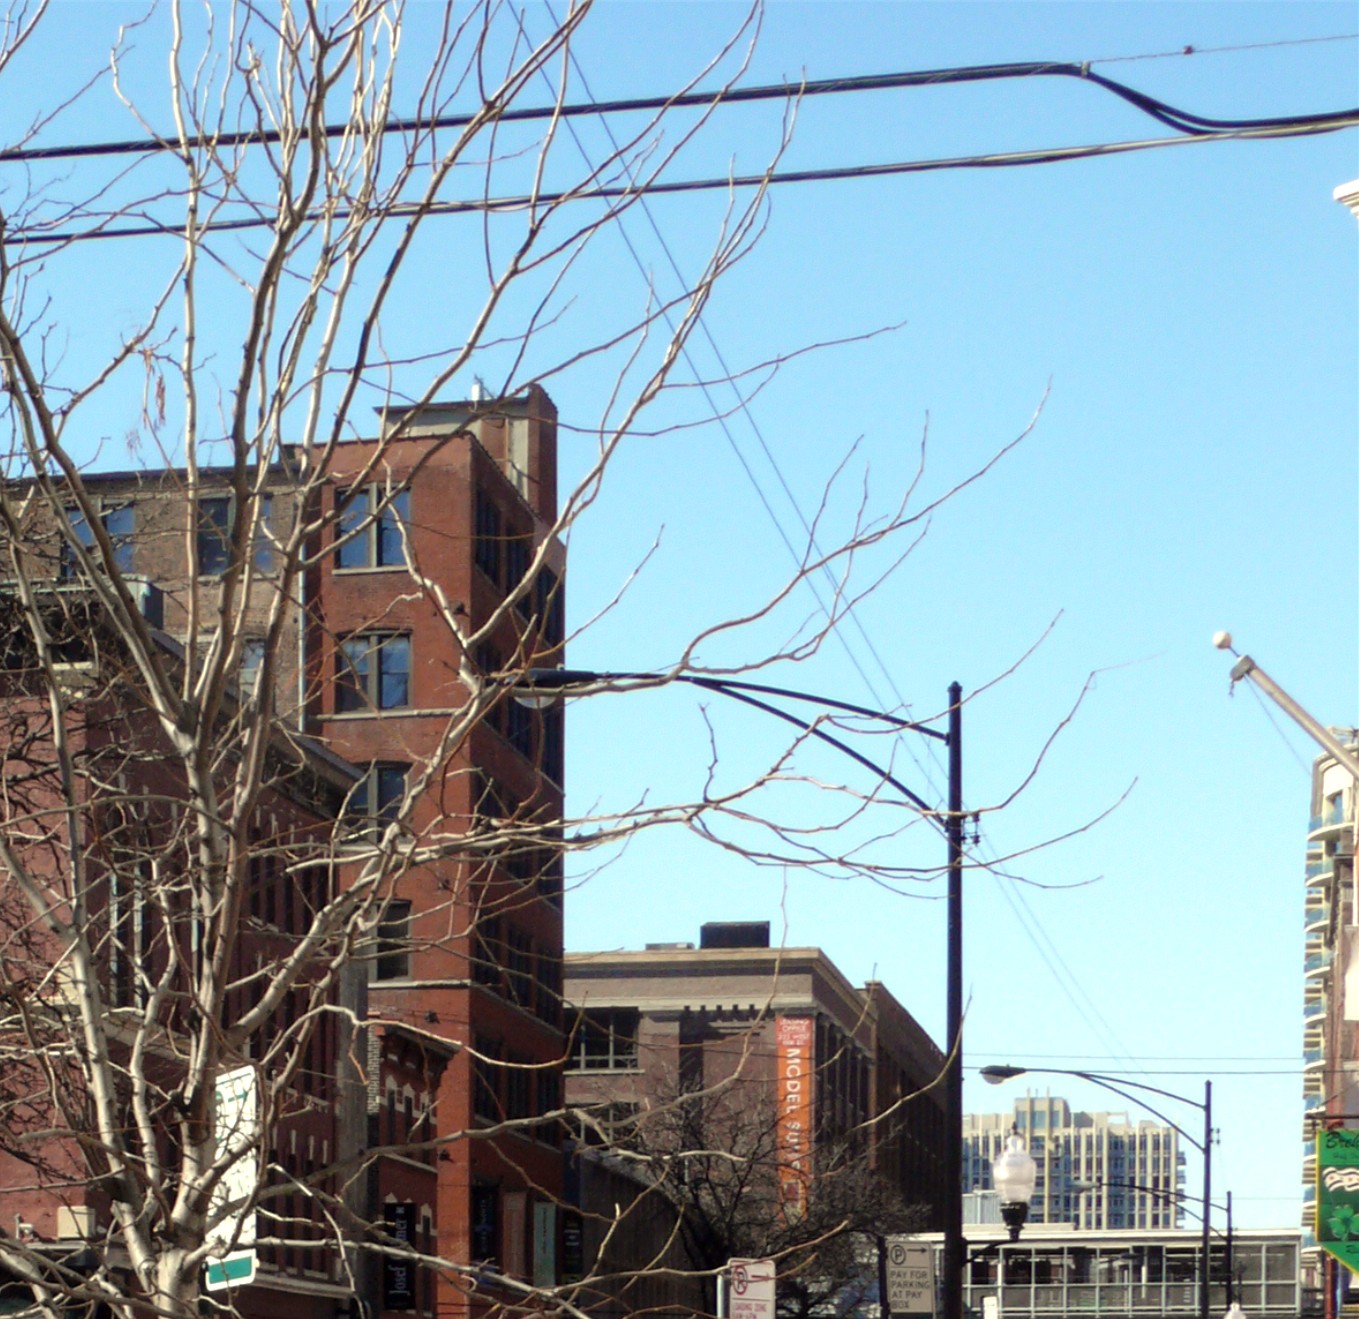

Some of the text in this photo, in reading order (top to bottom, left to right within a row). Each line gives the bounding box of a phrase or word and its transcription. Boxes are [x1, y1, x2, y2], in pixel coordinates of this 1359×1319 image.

[786, 1048, 801, 1114] MODEL
[890, 1269, 928, 1279] PAY FOR
[387, 1264, 411, 1297] Josef
[890, 1280, 930, 1290] PARKING
[891, 1290, 923, 1299] AT PAY
